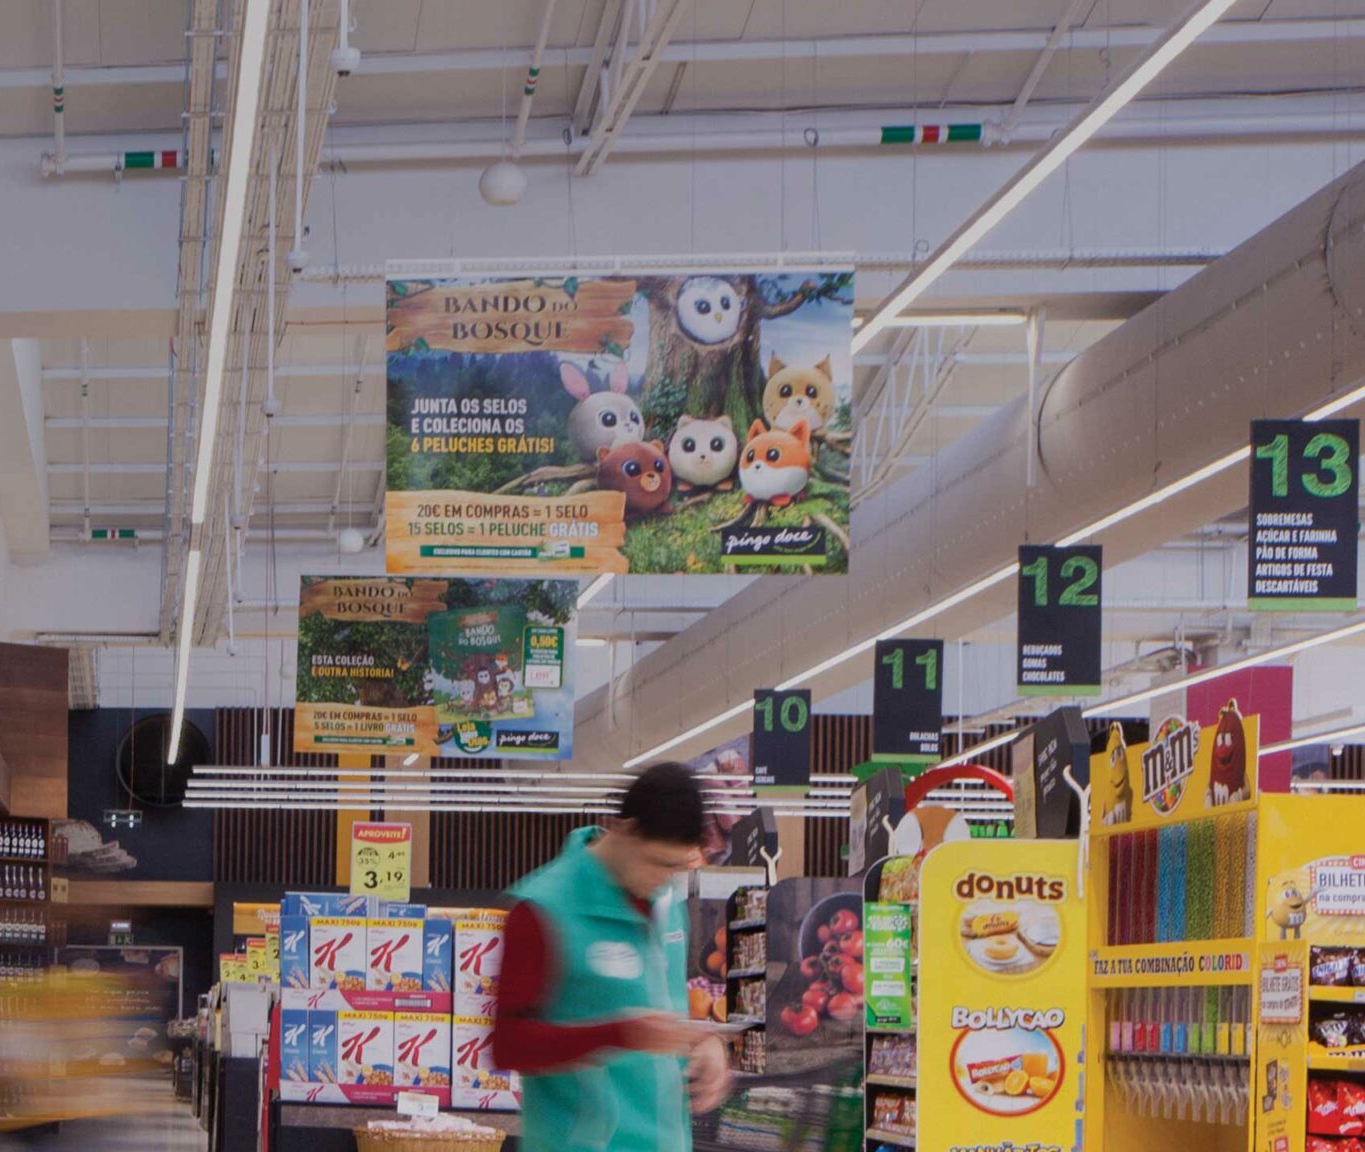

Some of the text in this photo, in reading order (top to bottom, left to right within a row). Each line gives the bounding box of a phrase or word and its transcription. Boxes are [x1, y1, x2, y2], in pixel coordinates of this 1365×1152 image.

[444, 295, 579, 315] BANDO DO
[451, 320, 569, 346] BOSQUE
[410, 398, 528, 415] JUNTA OS SELOS
[411, 417, 525, 434] E COLECIONA OS
[411, 435, 555, 453] 6 PELUCHES GRÁTIS!
[1255, 433, 1352, 499] 13
[417, 504, 441, 519] 20€
[444, 504, 463, 519] EM
[465, 504, 530, 519] COMPRAS
[555, 504, 589, 519] SELO
[1256, 512, 1314, 527] SOBREMESAS
[407, 522, 422, 536] 15
[424, 522, 465, 536] SELOS
[488, 522, 546, 537] PELUCHE
[549, 519, 599, 537] GRÁTIS
[1255, 528, 1338, 545] AÇÚCAR E FARINHA
[724, 528, 814, 555] pingo doce
[1255, 543, 1318, 560] PÃO DE FORMA
[1255, 562, 1334, 577] ARTIGOS DE FESTA
[1021, 555, 1100, 608] 12
[1255, 578, 1319, 594] DESCARTÁVEIS
[333, 585, 395, 598] BANDO
[336, 602, 407, 617] BOSQUE
[311, 654, 375, 668] ESTA COLEÇÃO
[882, 648, 937, 690] 11
[319, 667, 349, 678] OUTRA
[1022, 670, 1066, 683] CHOCOLATES
[755, 695, 808, 733] 10
[956, 873, 1065, 901] donuts
[1094, 952, 1250, 977] FAZ A TUA COMBINAÇÃO COLORID
[951, 1006, 1065, 1032] BOLLYCAO
